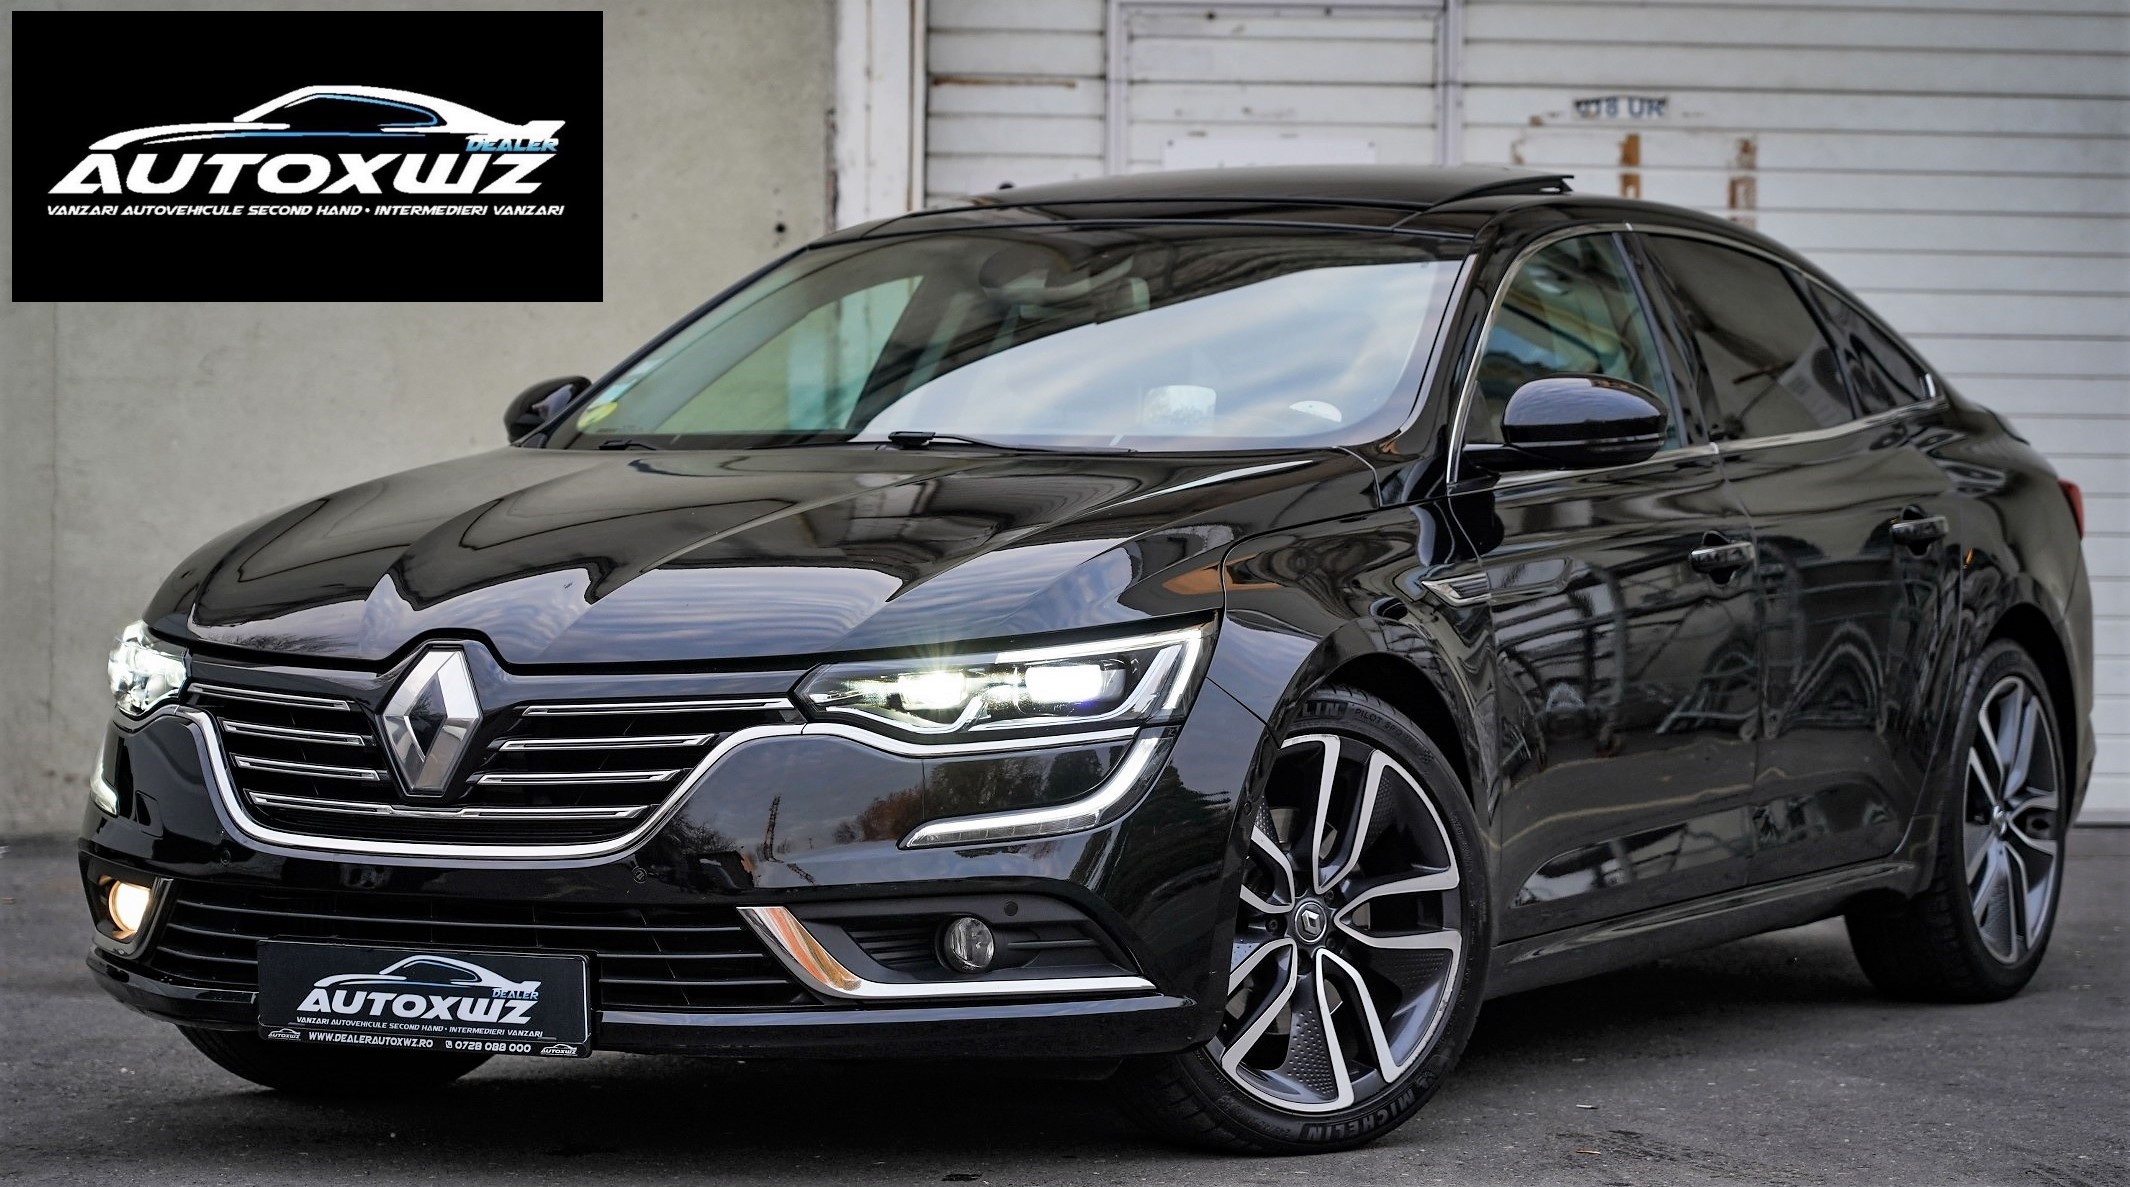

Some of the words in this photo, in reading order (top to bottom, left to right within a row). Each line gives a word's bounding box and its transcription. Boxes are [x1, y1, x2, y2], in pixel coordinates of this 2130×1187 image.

[491, 987, 540, 1000] DEALER
[296, 988, 539, 1025] AUTOXWZ
[296, 1016, 330, 1025] VANZARI
[330, 1018, 388, 1029] AUTOVEHICULE
[388, 1022, 420, 1031] SECOND
[449, 1026, 506, 1035] INTERMEDIERI
[507, 1029, 544, 1037] VANZARI
[308, 1031, 434, 1048] WWW.DEALERAUTOXWZ.RO
[454, 1040, 483, 1051] 0728
[484, 1042, 507, 1052] 088
[508, 1043, 532, 1053] 000
[1306, 1087, 1416, 1141] MICHELIN
